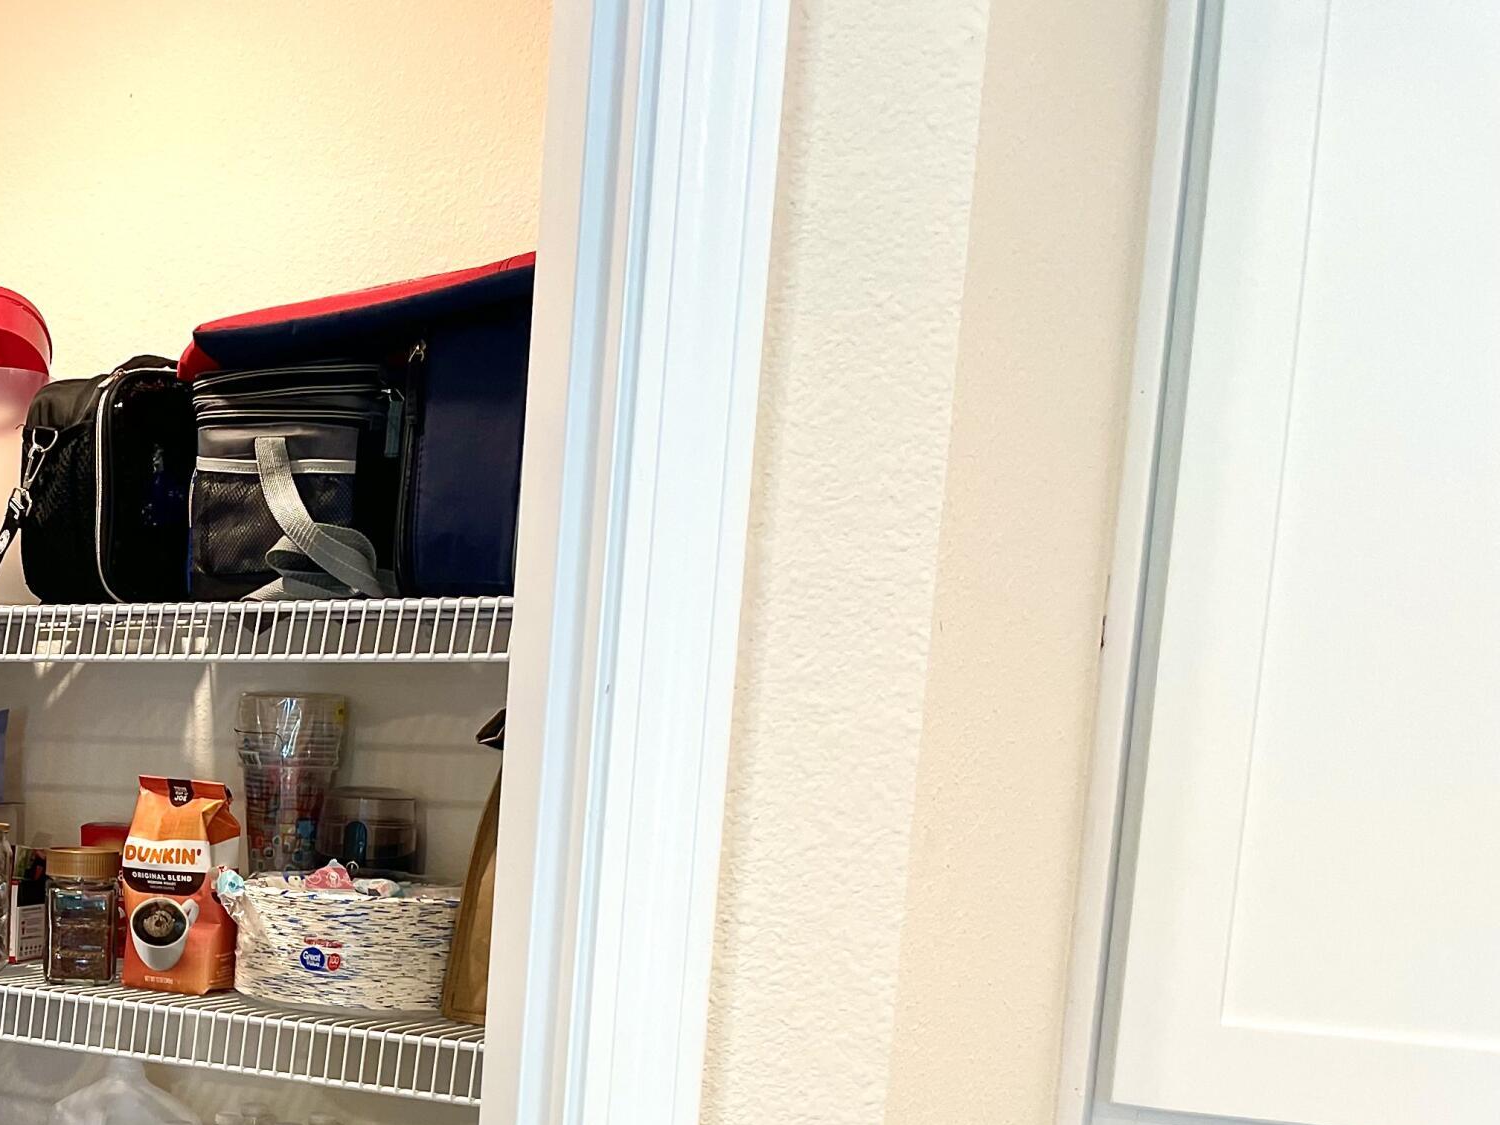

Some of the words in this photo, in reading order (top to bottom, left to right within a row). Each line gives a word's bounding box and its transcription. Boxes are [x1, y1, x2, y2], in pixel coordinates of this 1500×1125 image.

[124, 844, 202, 865] DUNKIN'
[132, 871, 166, 881] ORIGINAL
[168, 874, 192, 882] BLEND
[302, 950, 321, 962] Great
